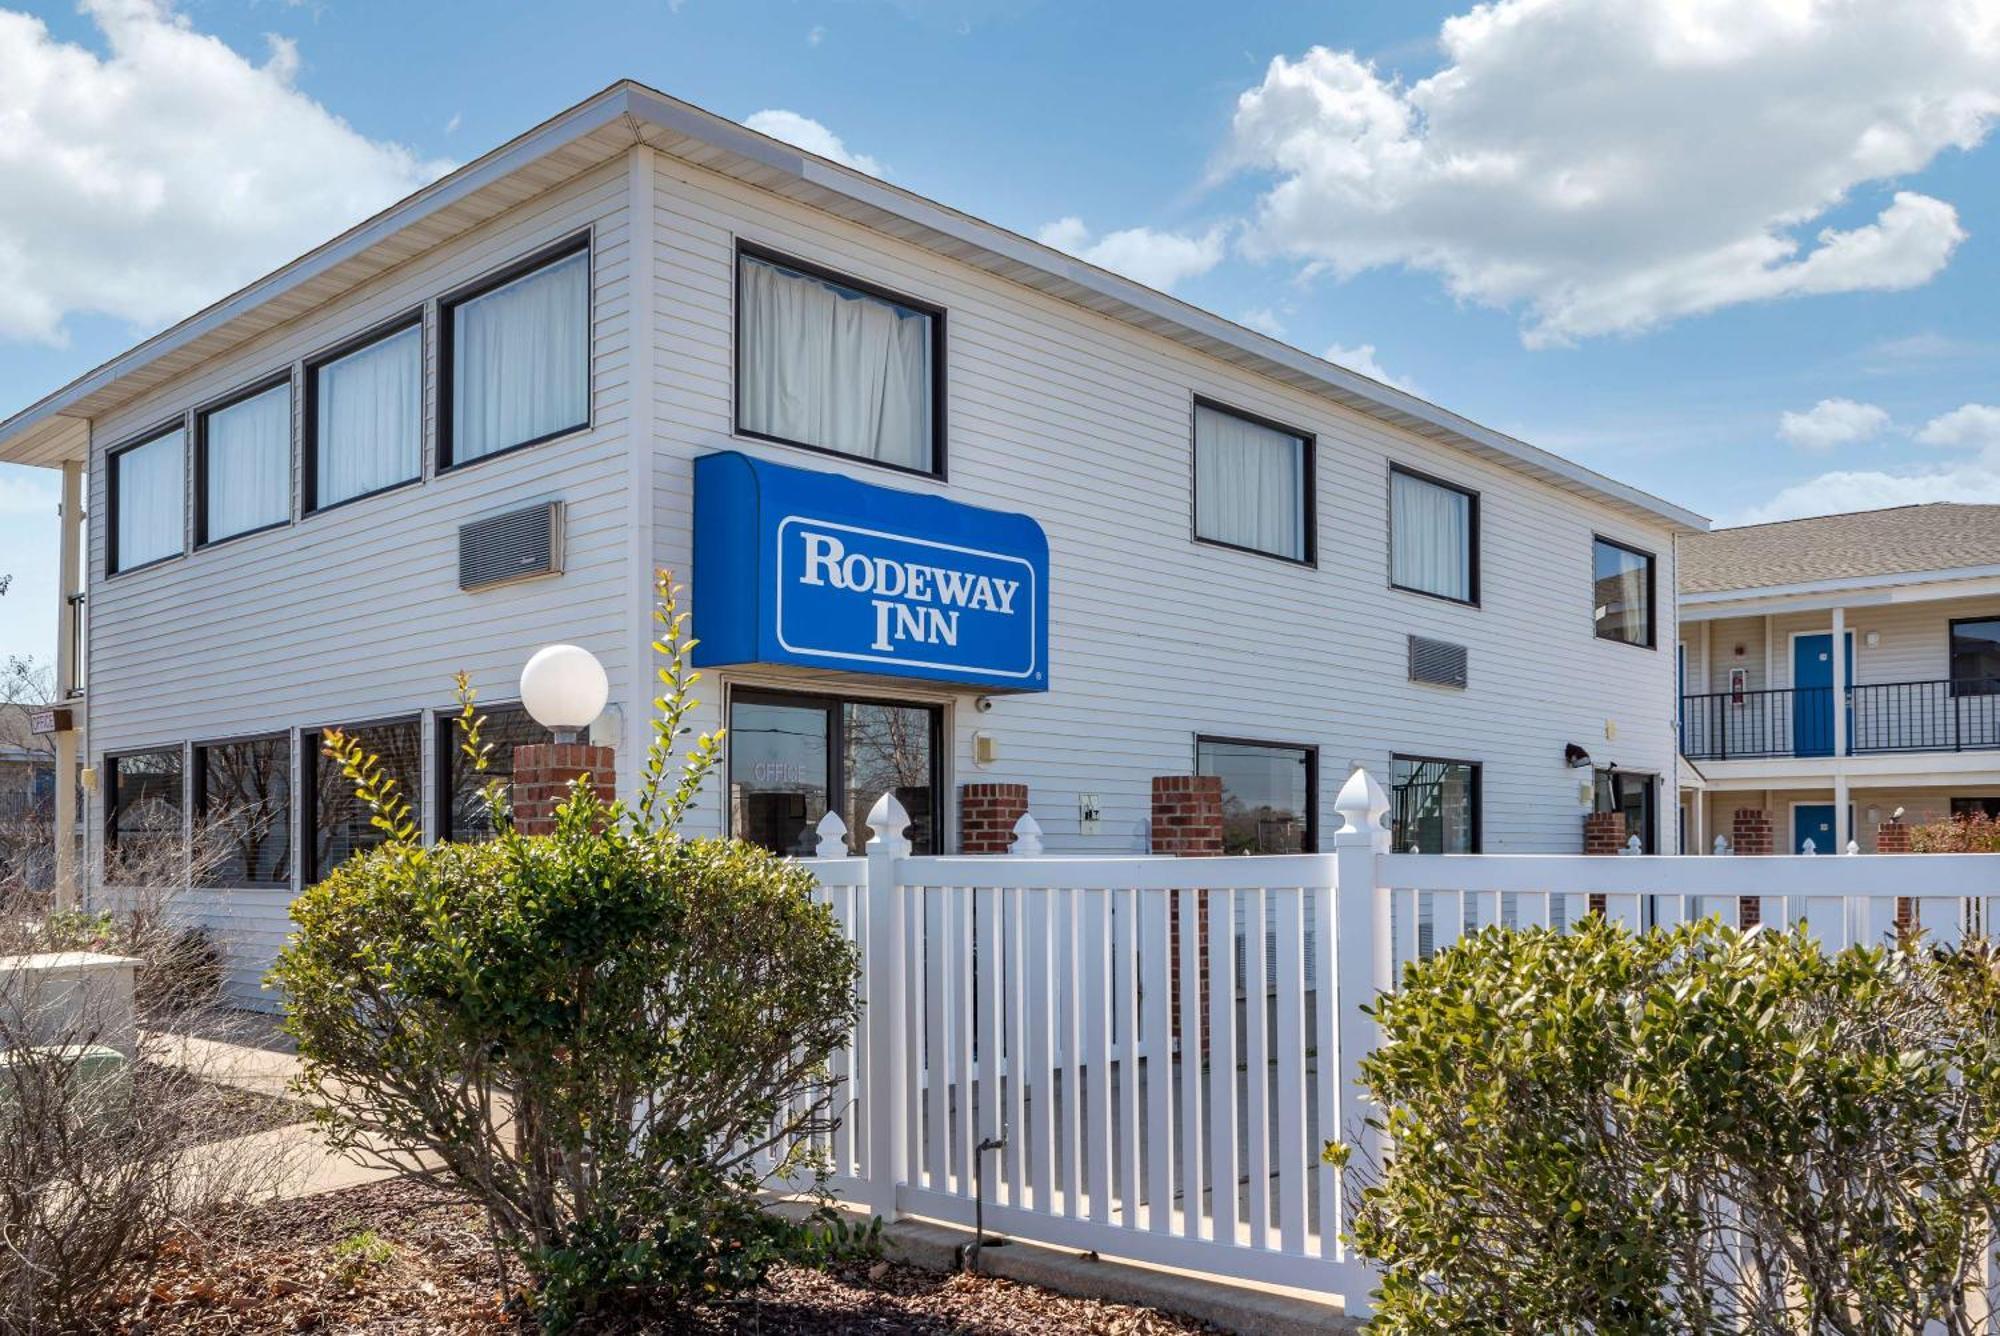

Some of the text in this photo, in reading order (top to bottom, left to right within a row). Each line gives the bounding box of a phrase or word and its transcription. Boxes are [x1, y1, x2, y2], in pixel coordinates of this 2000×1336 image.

[800, 531, 1019, 614] RODEWAY
[871, 600, 959, 651] INN
[754, 762, 807, 782] OFFICE
